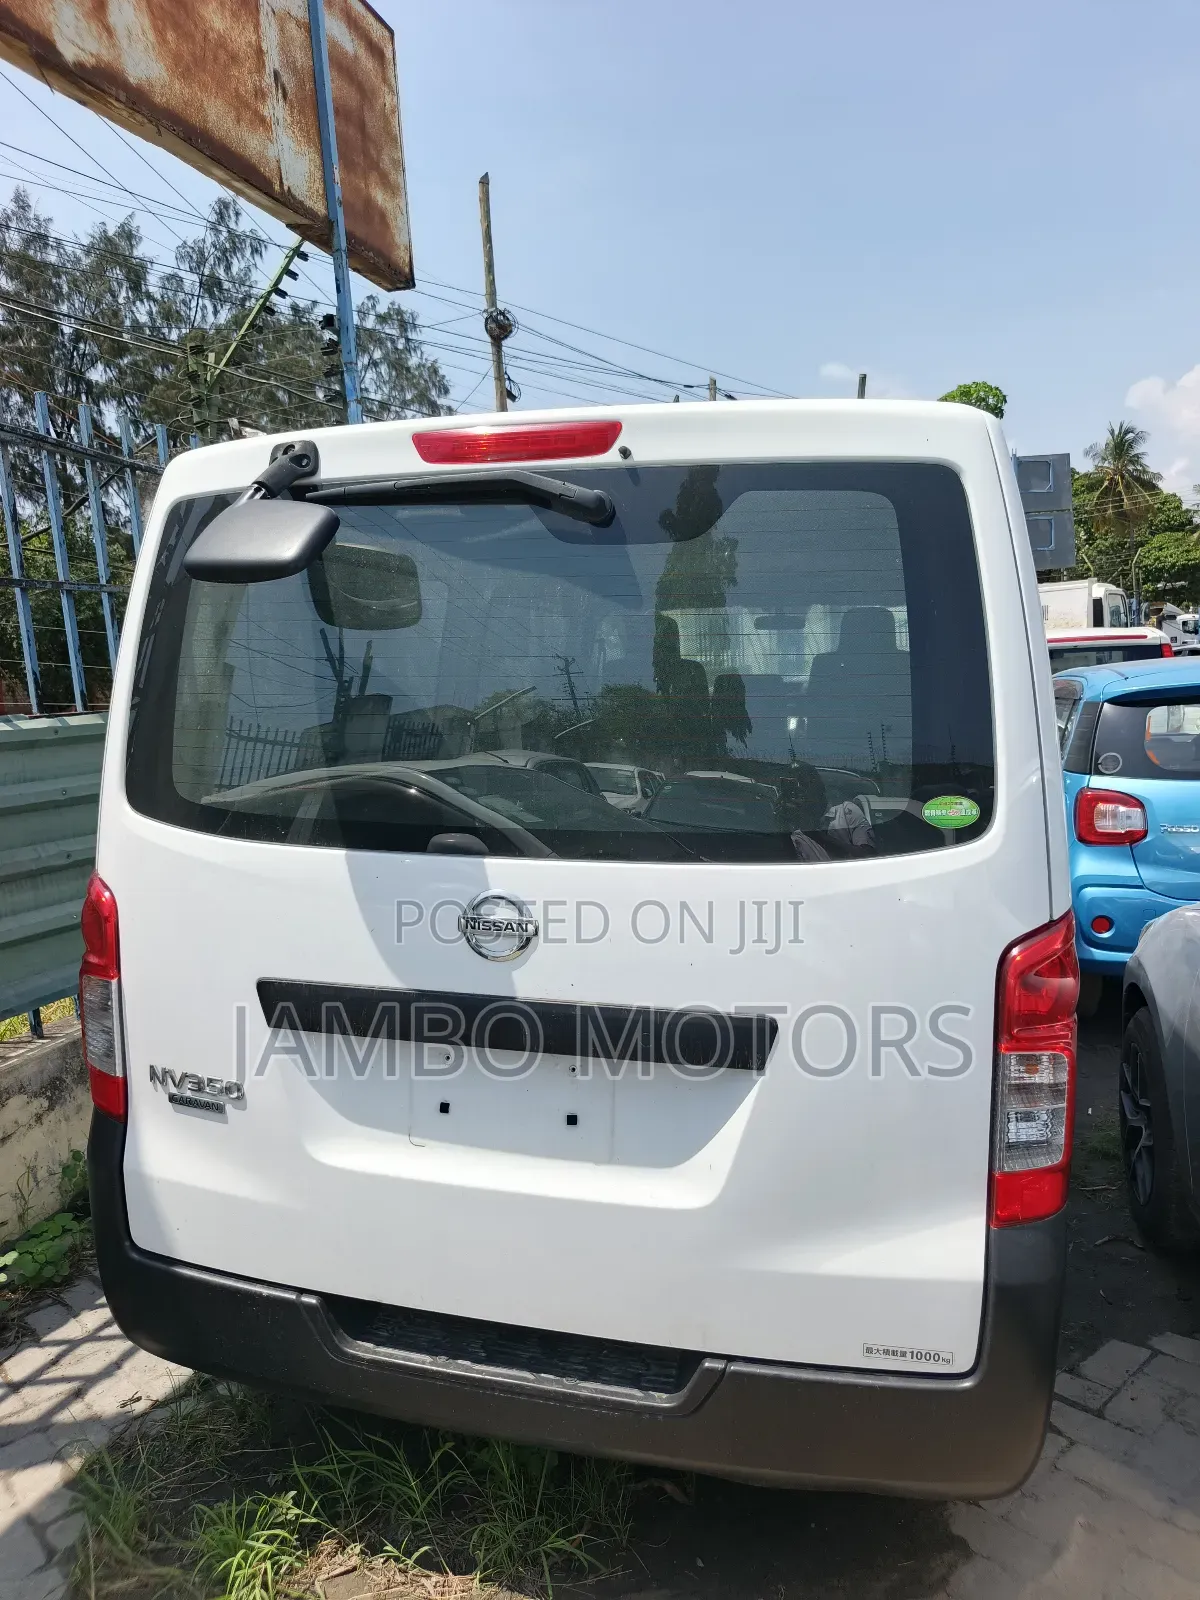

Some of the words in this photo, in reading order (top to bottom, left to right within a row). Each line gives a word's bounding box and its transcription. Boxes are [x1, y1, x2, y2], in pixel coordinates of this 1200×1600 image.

[465, 919, 529, 933] NISSAN
[149, 1064, 245, 1100] NV350
[170, 1094, 220, 1112] CARAVAN
